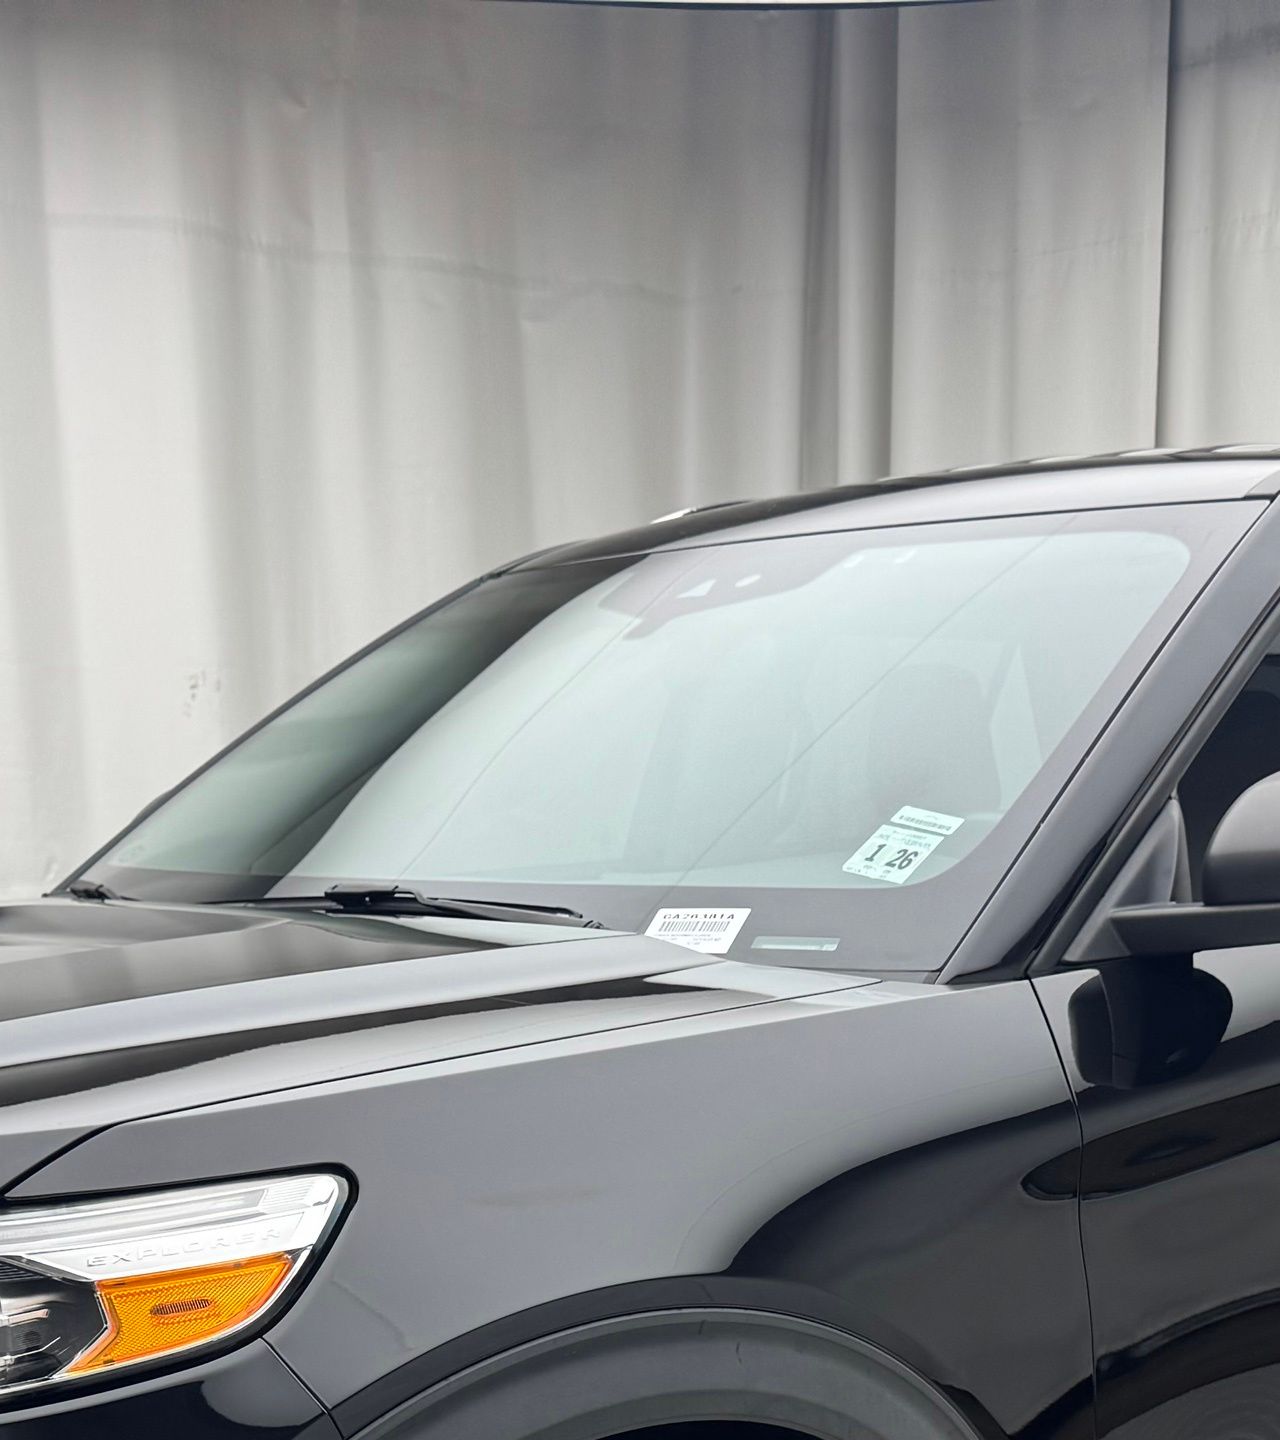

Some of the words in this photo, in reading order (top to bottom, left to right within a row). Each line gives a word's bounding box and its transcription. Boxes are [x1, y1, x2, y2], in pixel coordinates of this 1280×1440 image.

[864, 843, 887, 862] 1
[885, 848, 918, 870] 26
[86, 1228, 281, 1268] EXPLORER
